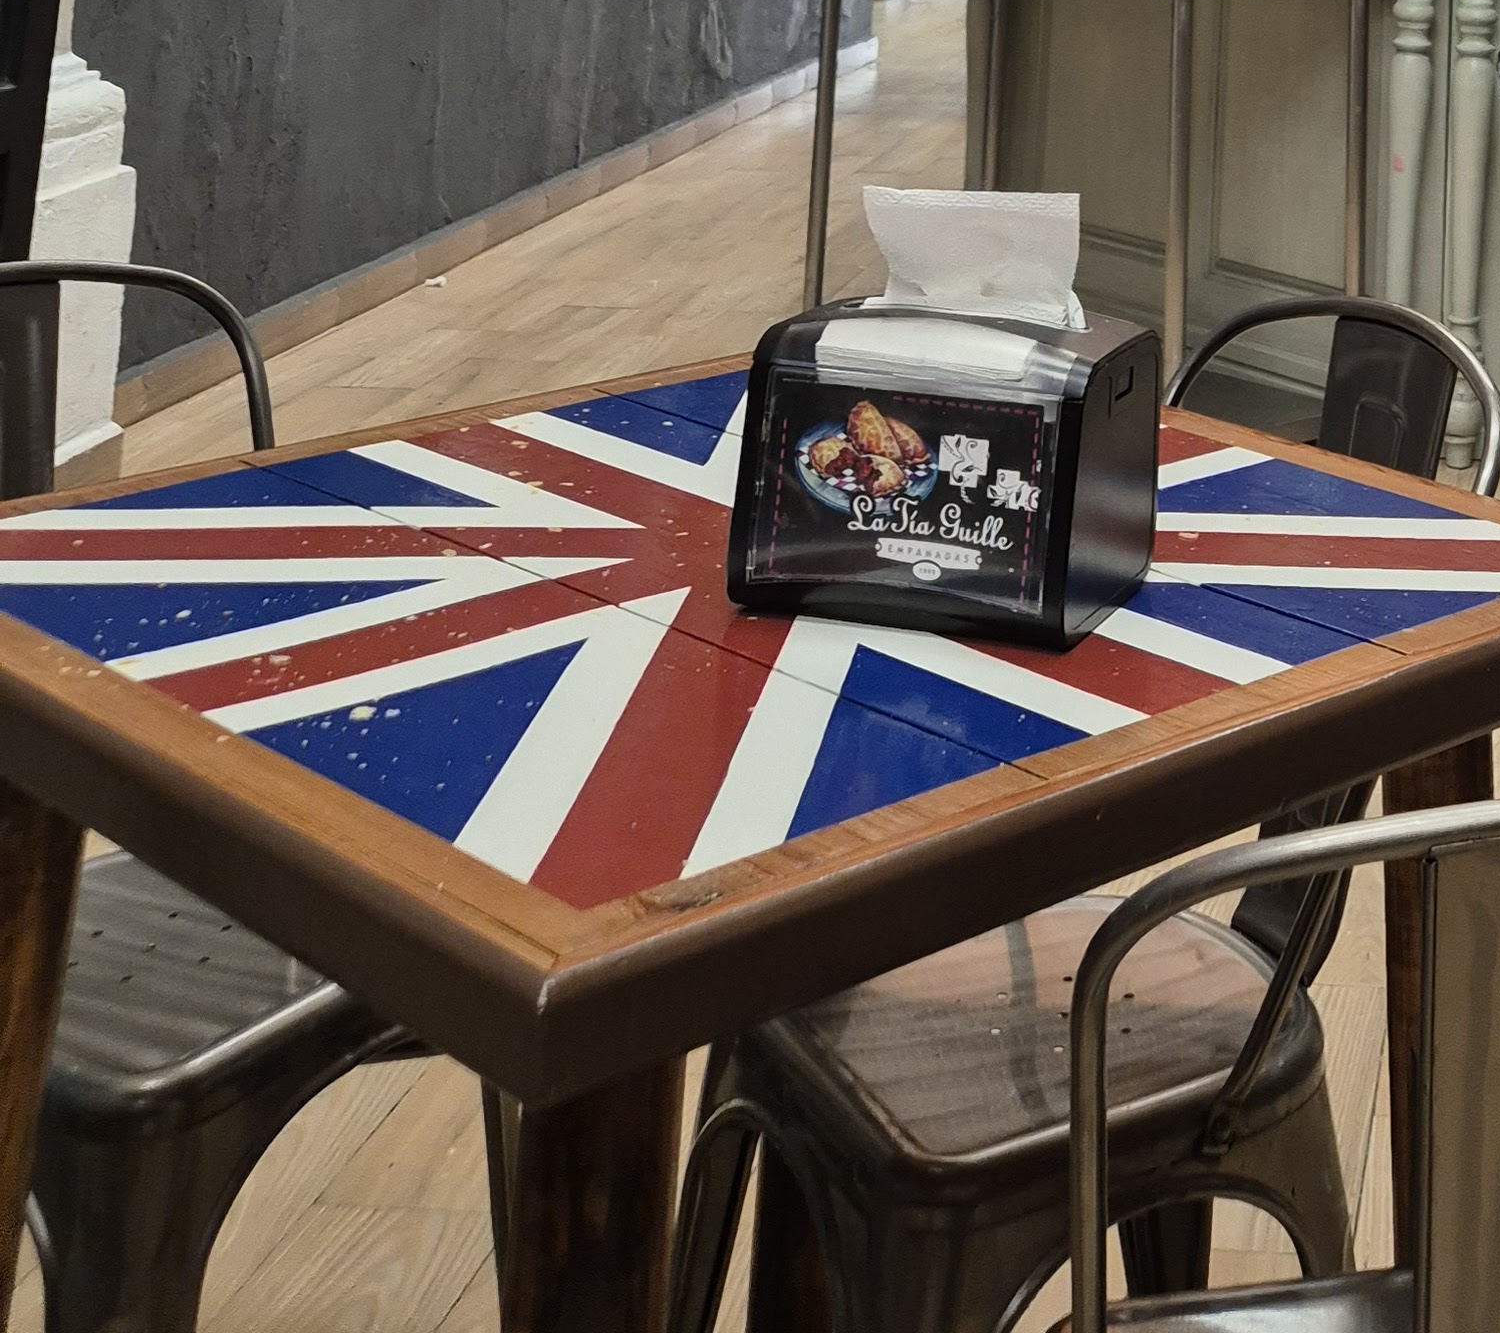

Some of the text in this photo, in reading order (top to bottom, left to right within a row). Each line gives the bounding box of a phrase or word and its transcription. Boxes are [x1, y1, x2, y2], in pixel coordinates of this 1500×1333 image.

[847, 494, 1014, 551] La Tía Guille
[887, 544, 970, 564] EMPANADAS
